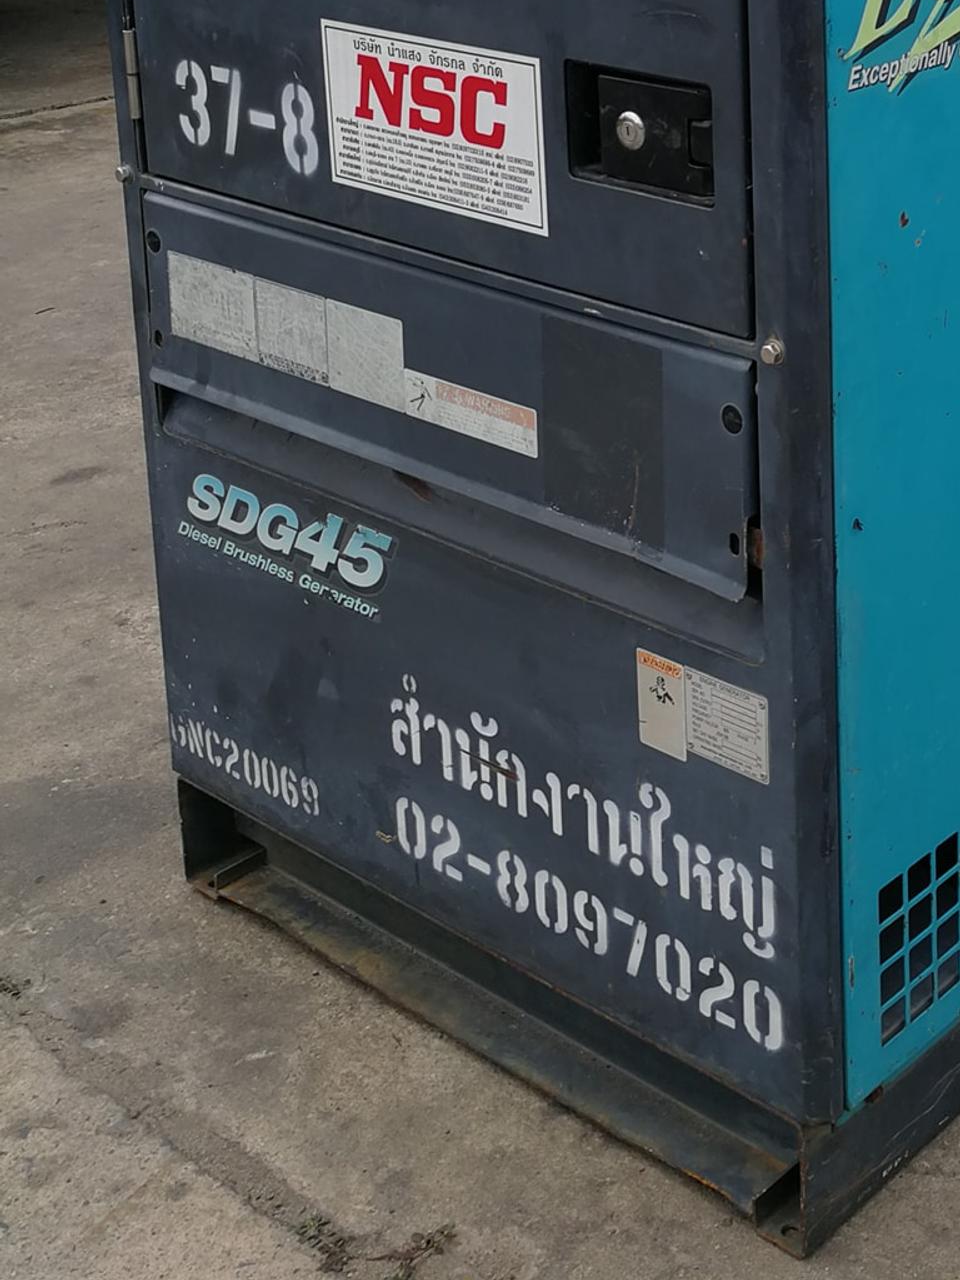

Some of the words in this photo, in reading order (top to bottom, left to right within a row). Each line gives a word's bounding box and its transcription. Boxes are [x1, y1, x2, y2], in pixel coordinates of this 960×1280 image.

[352, 37, 382, 55] บริษัท
[472, 57, 504, 79] จำกัด
[354, 53, 508, 150] NSC
[848, 37, 957, 91] Exceptionally
[175, 60, 320, 177] 37-8
[177, 520, 222, 551] Diesel
[223, 540, 295, 584] Brushless
[186, 473, 393, 588] SDG45
[391, 672, 776, 960] สำนักงานใหญ่
[395, 796, 785, 1052] 02-8097020
